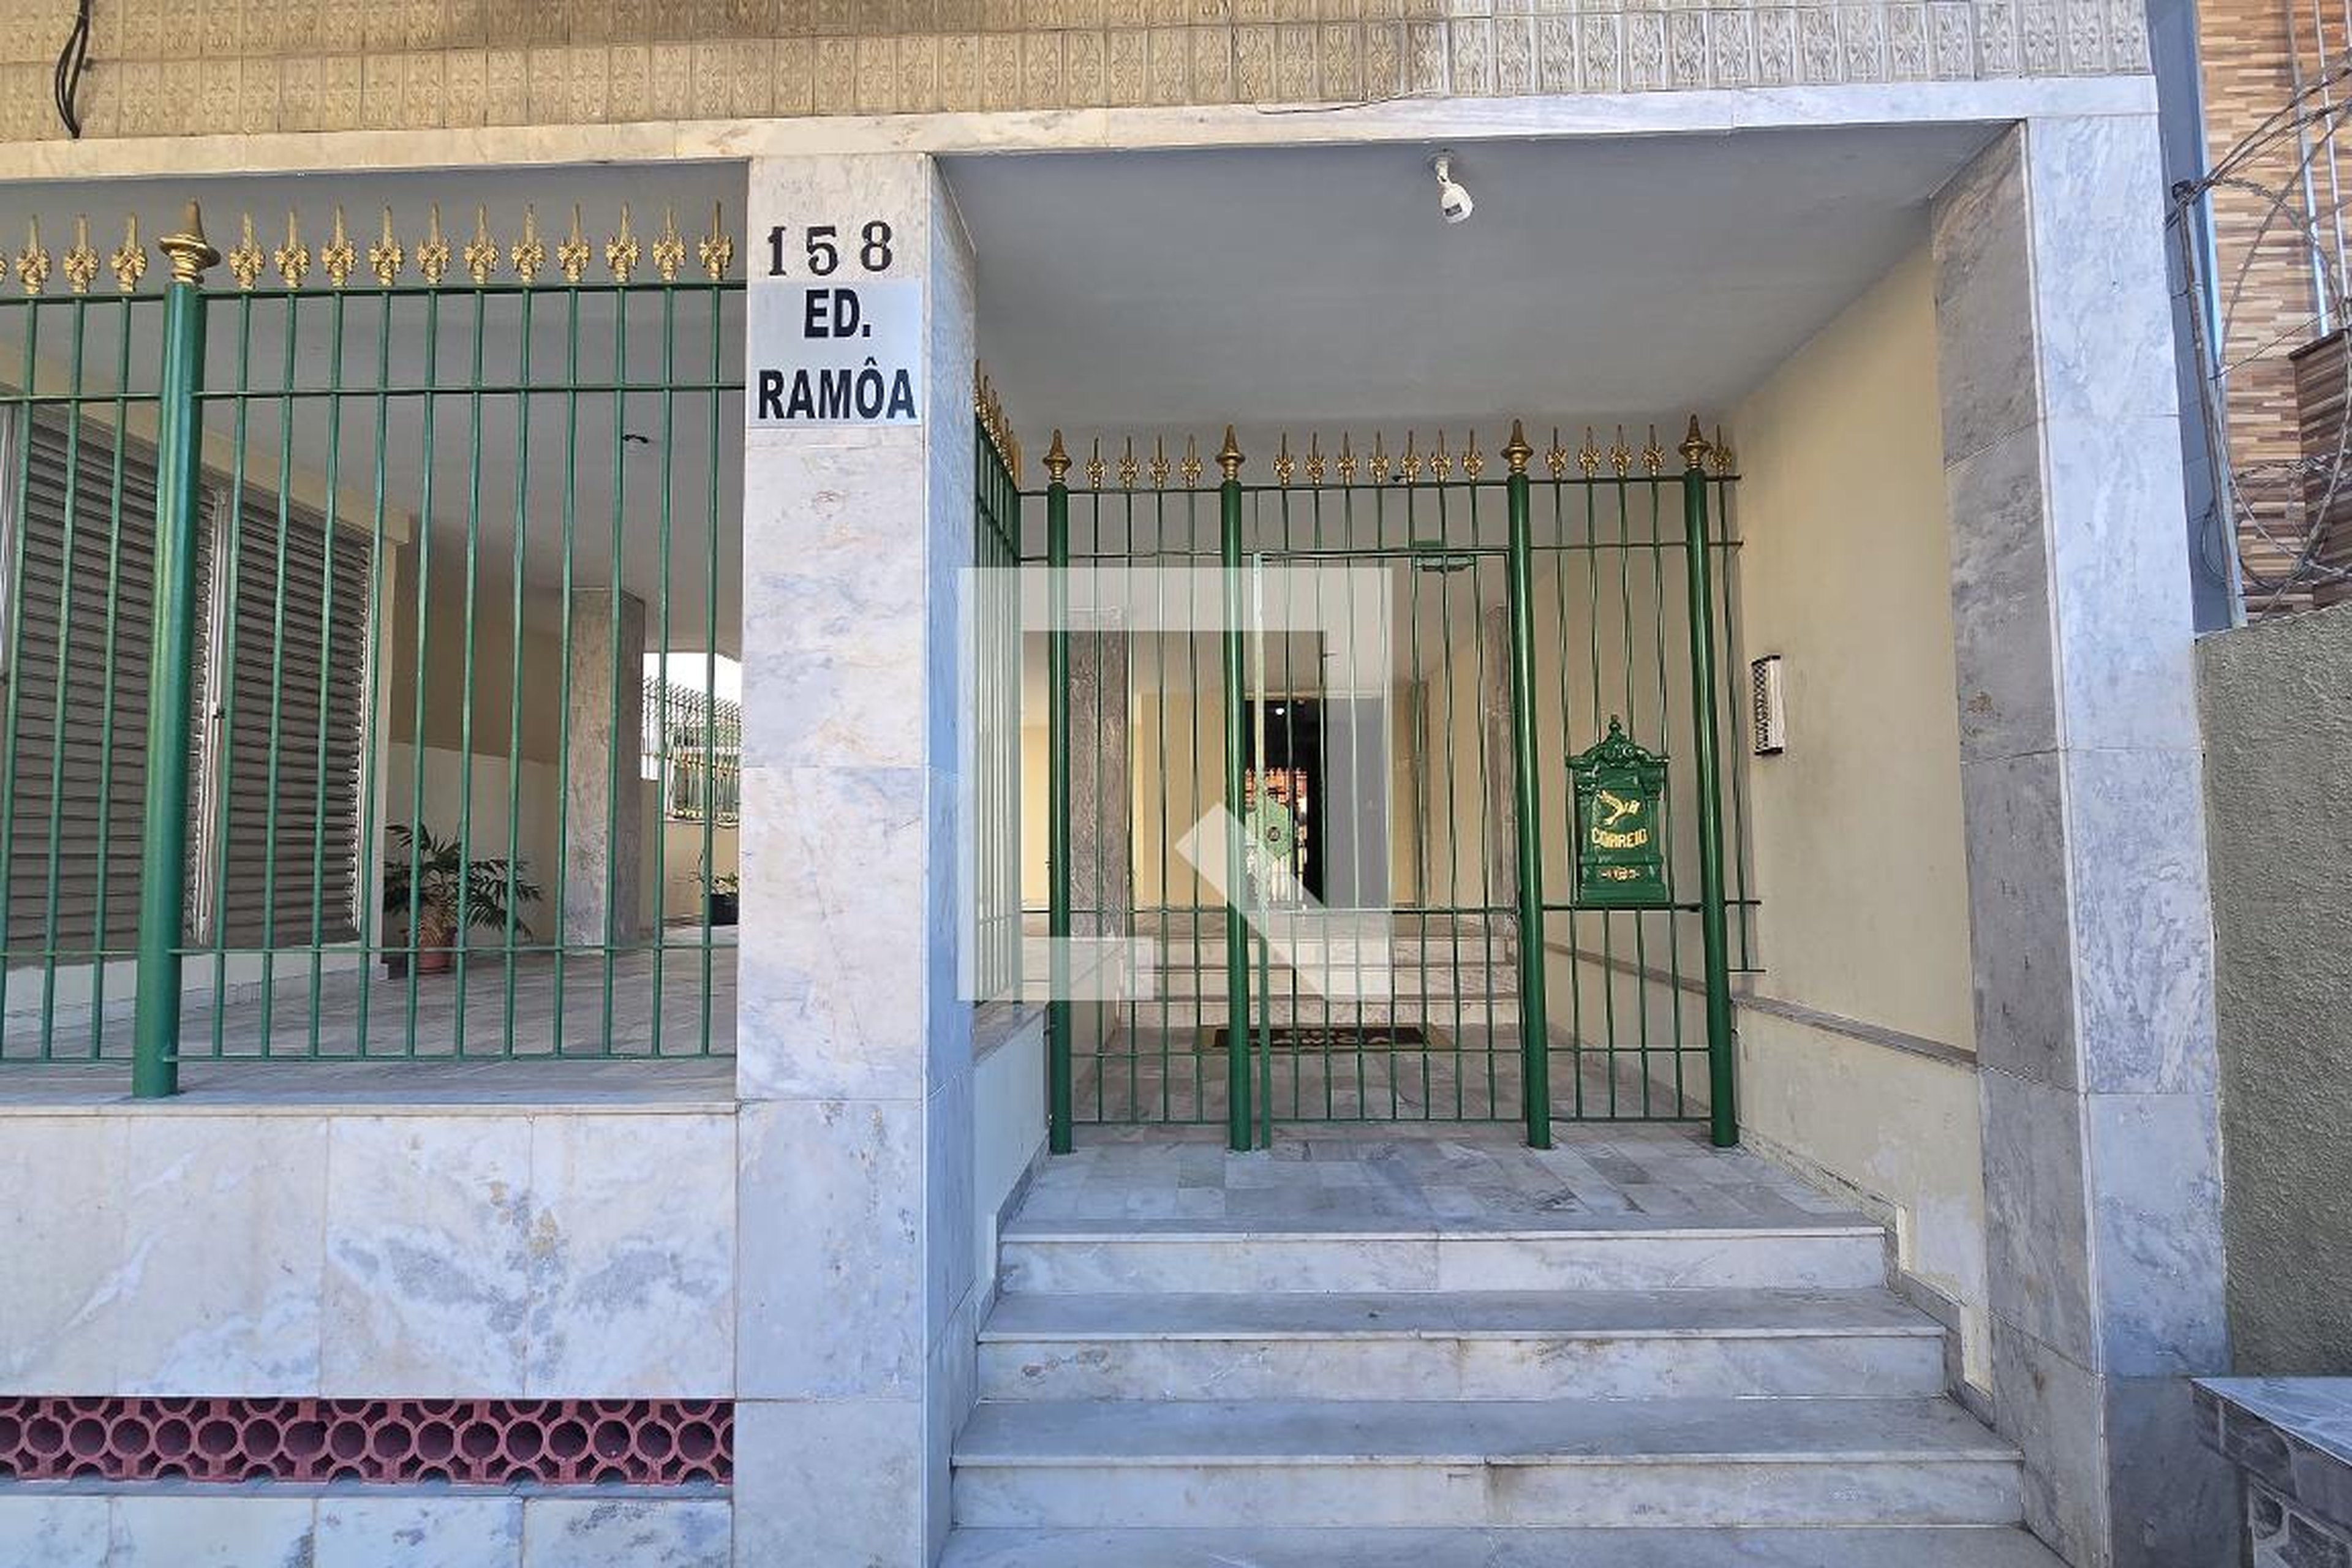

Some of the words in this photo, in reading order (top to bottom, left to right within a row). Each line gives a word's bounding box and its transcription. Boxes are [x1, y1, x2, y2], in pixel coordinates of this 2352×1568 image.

[767, 221, 893, 276] 158
[804, 288, 871, 338] ED.
[758, 356, 917, 420] RAMÔA
[1592, 827, 1648, 848] CORREIO
